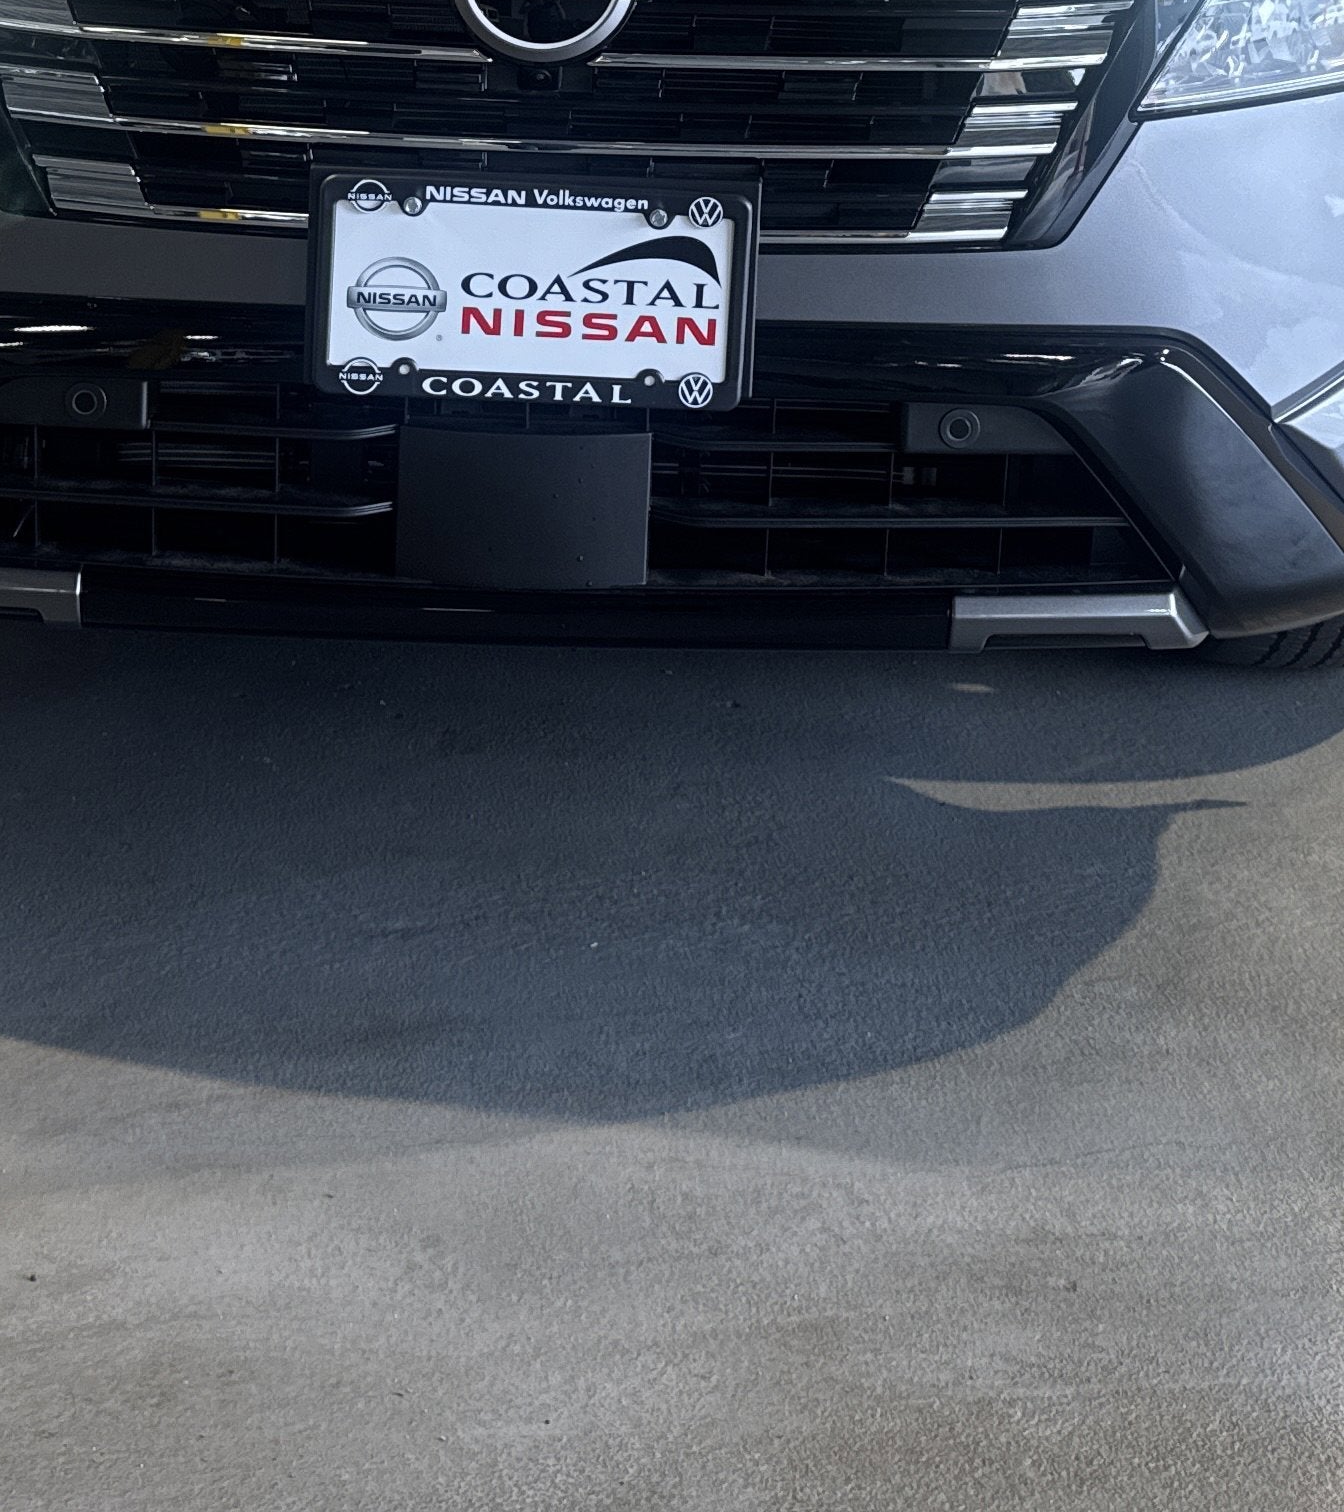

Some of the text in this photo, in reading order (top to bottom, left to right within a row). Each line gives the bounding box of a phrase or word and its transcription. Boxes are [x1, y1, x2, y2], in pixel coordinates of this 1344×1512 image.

[347, 192, 392, 201] NISSAN
[425, 185, 649, 212] NISSAN Volkswagen
[356, 291, 437, 307] NISSAN
[460, 272, 720, 310] COASTAL
[461, 306, 716, 346] NISSAN
[339, 372, 383, 381] NISSAN
[422, 376, 632, 404] COASTAL
